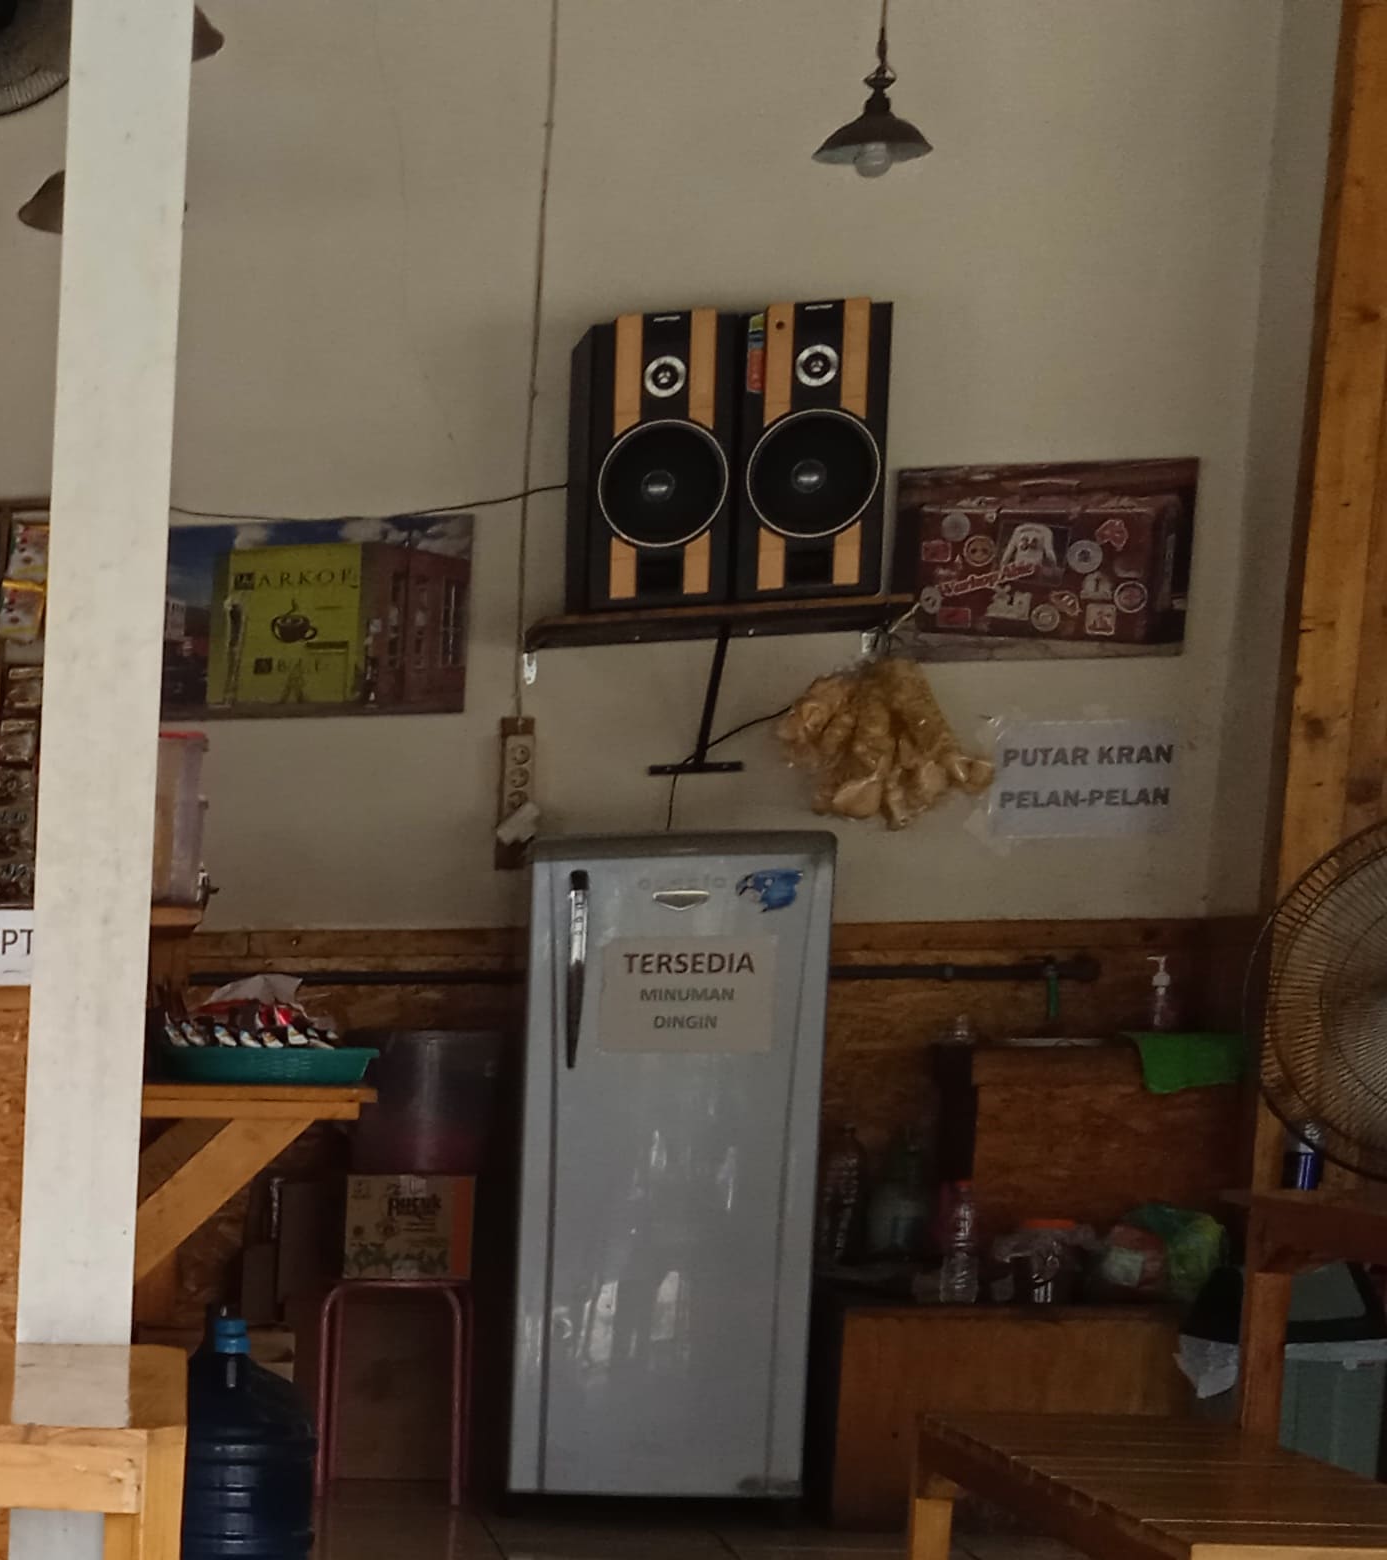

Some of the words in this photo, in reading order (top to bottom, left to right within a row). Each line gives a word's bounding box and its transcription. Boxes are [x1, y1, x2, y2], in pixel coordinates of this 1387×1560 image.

[1001, 747, 1089, 768] PUTAR
[1096, 744, 1175, 765] KRAN
[999, 787, 1171, 809] PELAN-PELAN
[623, 952, 755, 975] TERSEDIA
[639, 987, 735, 1002] MINUMAN
[652, 1014, 718, 1030] DINGIN
